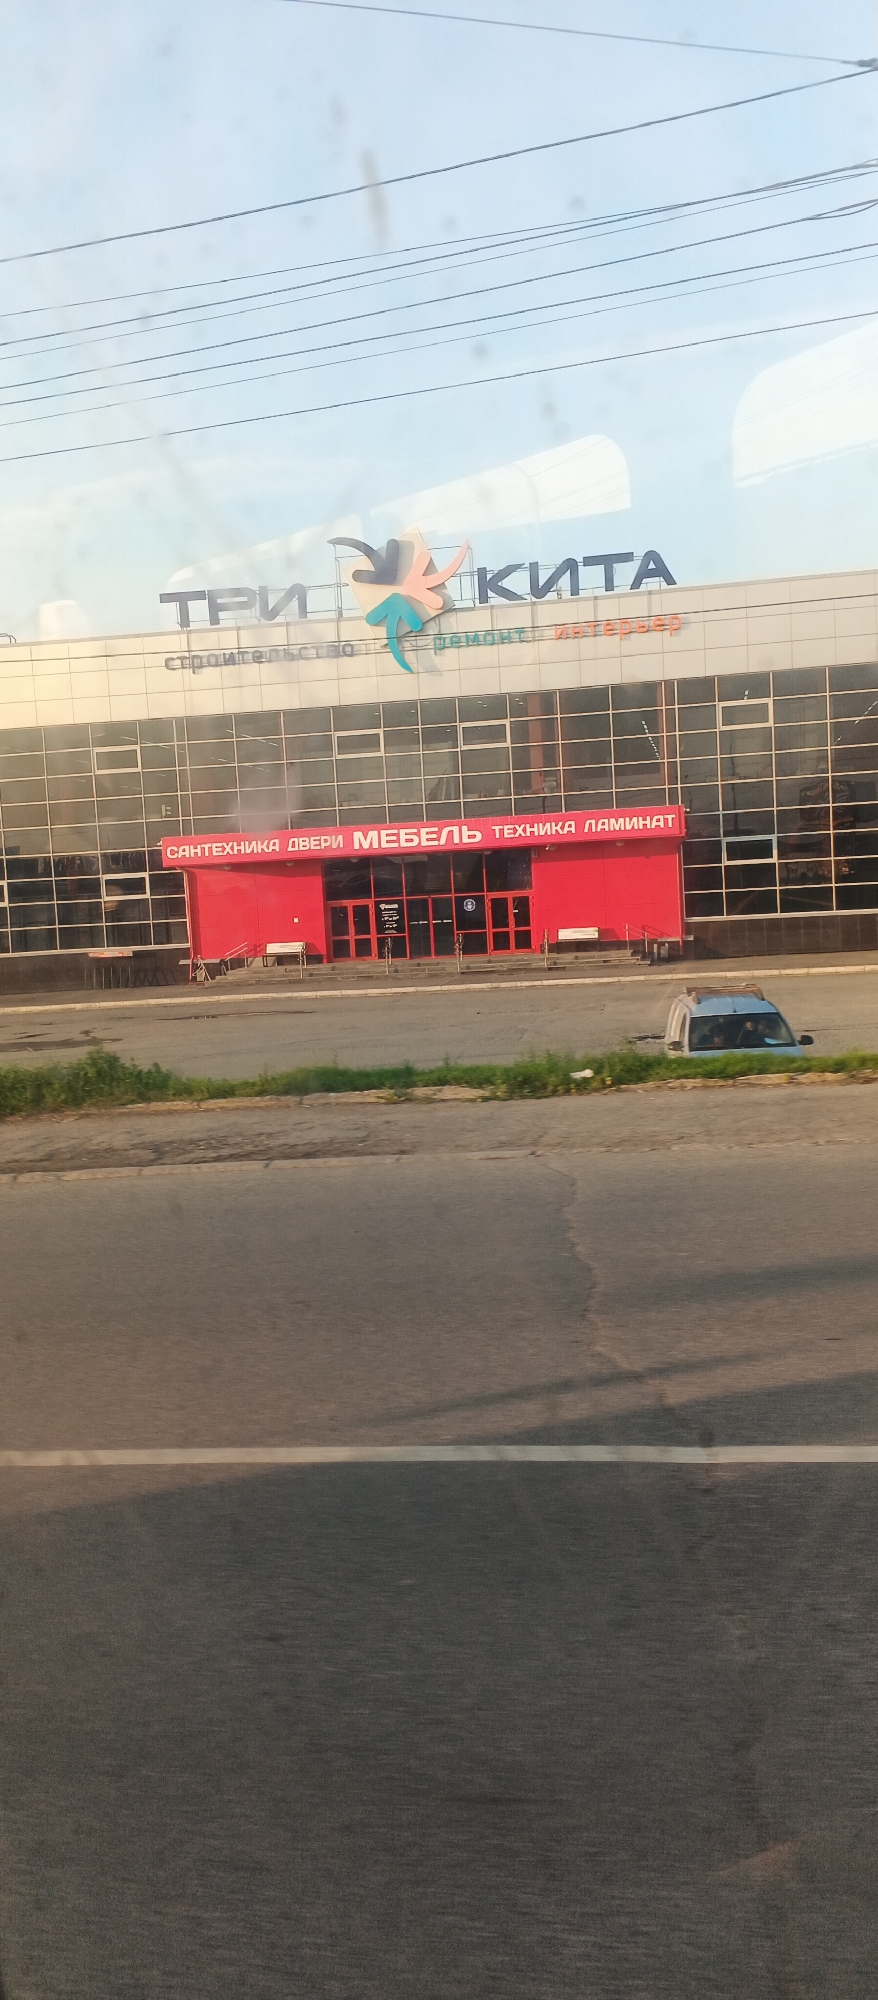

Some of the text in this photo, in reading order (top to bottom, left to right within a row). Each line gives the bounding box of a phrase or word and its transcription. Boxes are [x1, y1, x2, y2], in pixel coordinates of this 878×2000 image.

[159, 549, 678, 629] ТРИ КИТА
[164, 614, 683, 675] строительство ремонт интерьер
[166, 813, 676, 859] САНТЕХНИКА ДВЕРИ МЕБЕЛЬ ТЕХНИКА ЛАМИНАТ
